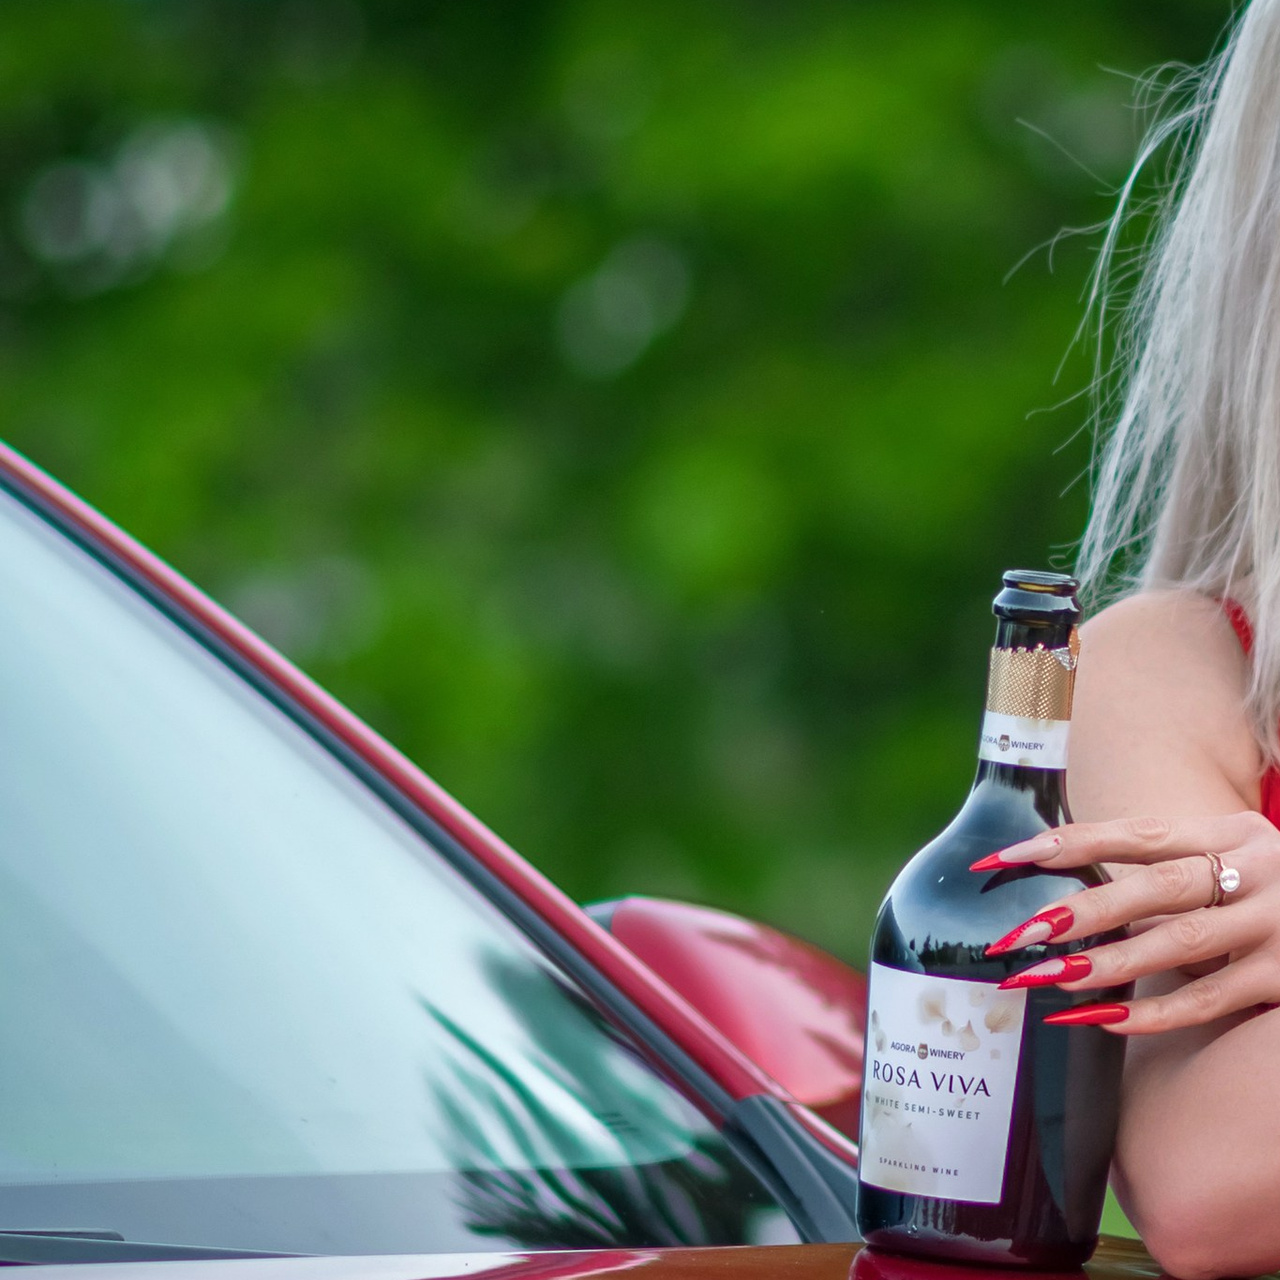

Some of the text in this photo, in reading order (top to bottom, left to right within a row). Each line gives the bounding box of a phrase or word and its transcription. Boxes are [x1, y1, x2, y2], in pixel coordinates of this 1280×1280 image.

[1011, 740, 1044, 751] WINERY
[890, 1041, 966, 1060] AGORA WINERY
[873, 1059, 991, 1097] ROSA VIVA
[875, 1095, 981, 1121] WHITE SEMI-SWEET
[879, 1156, 959, 1177] SPARKLING WINE
